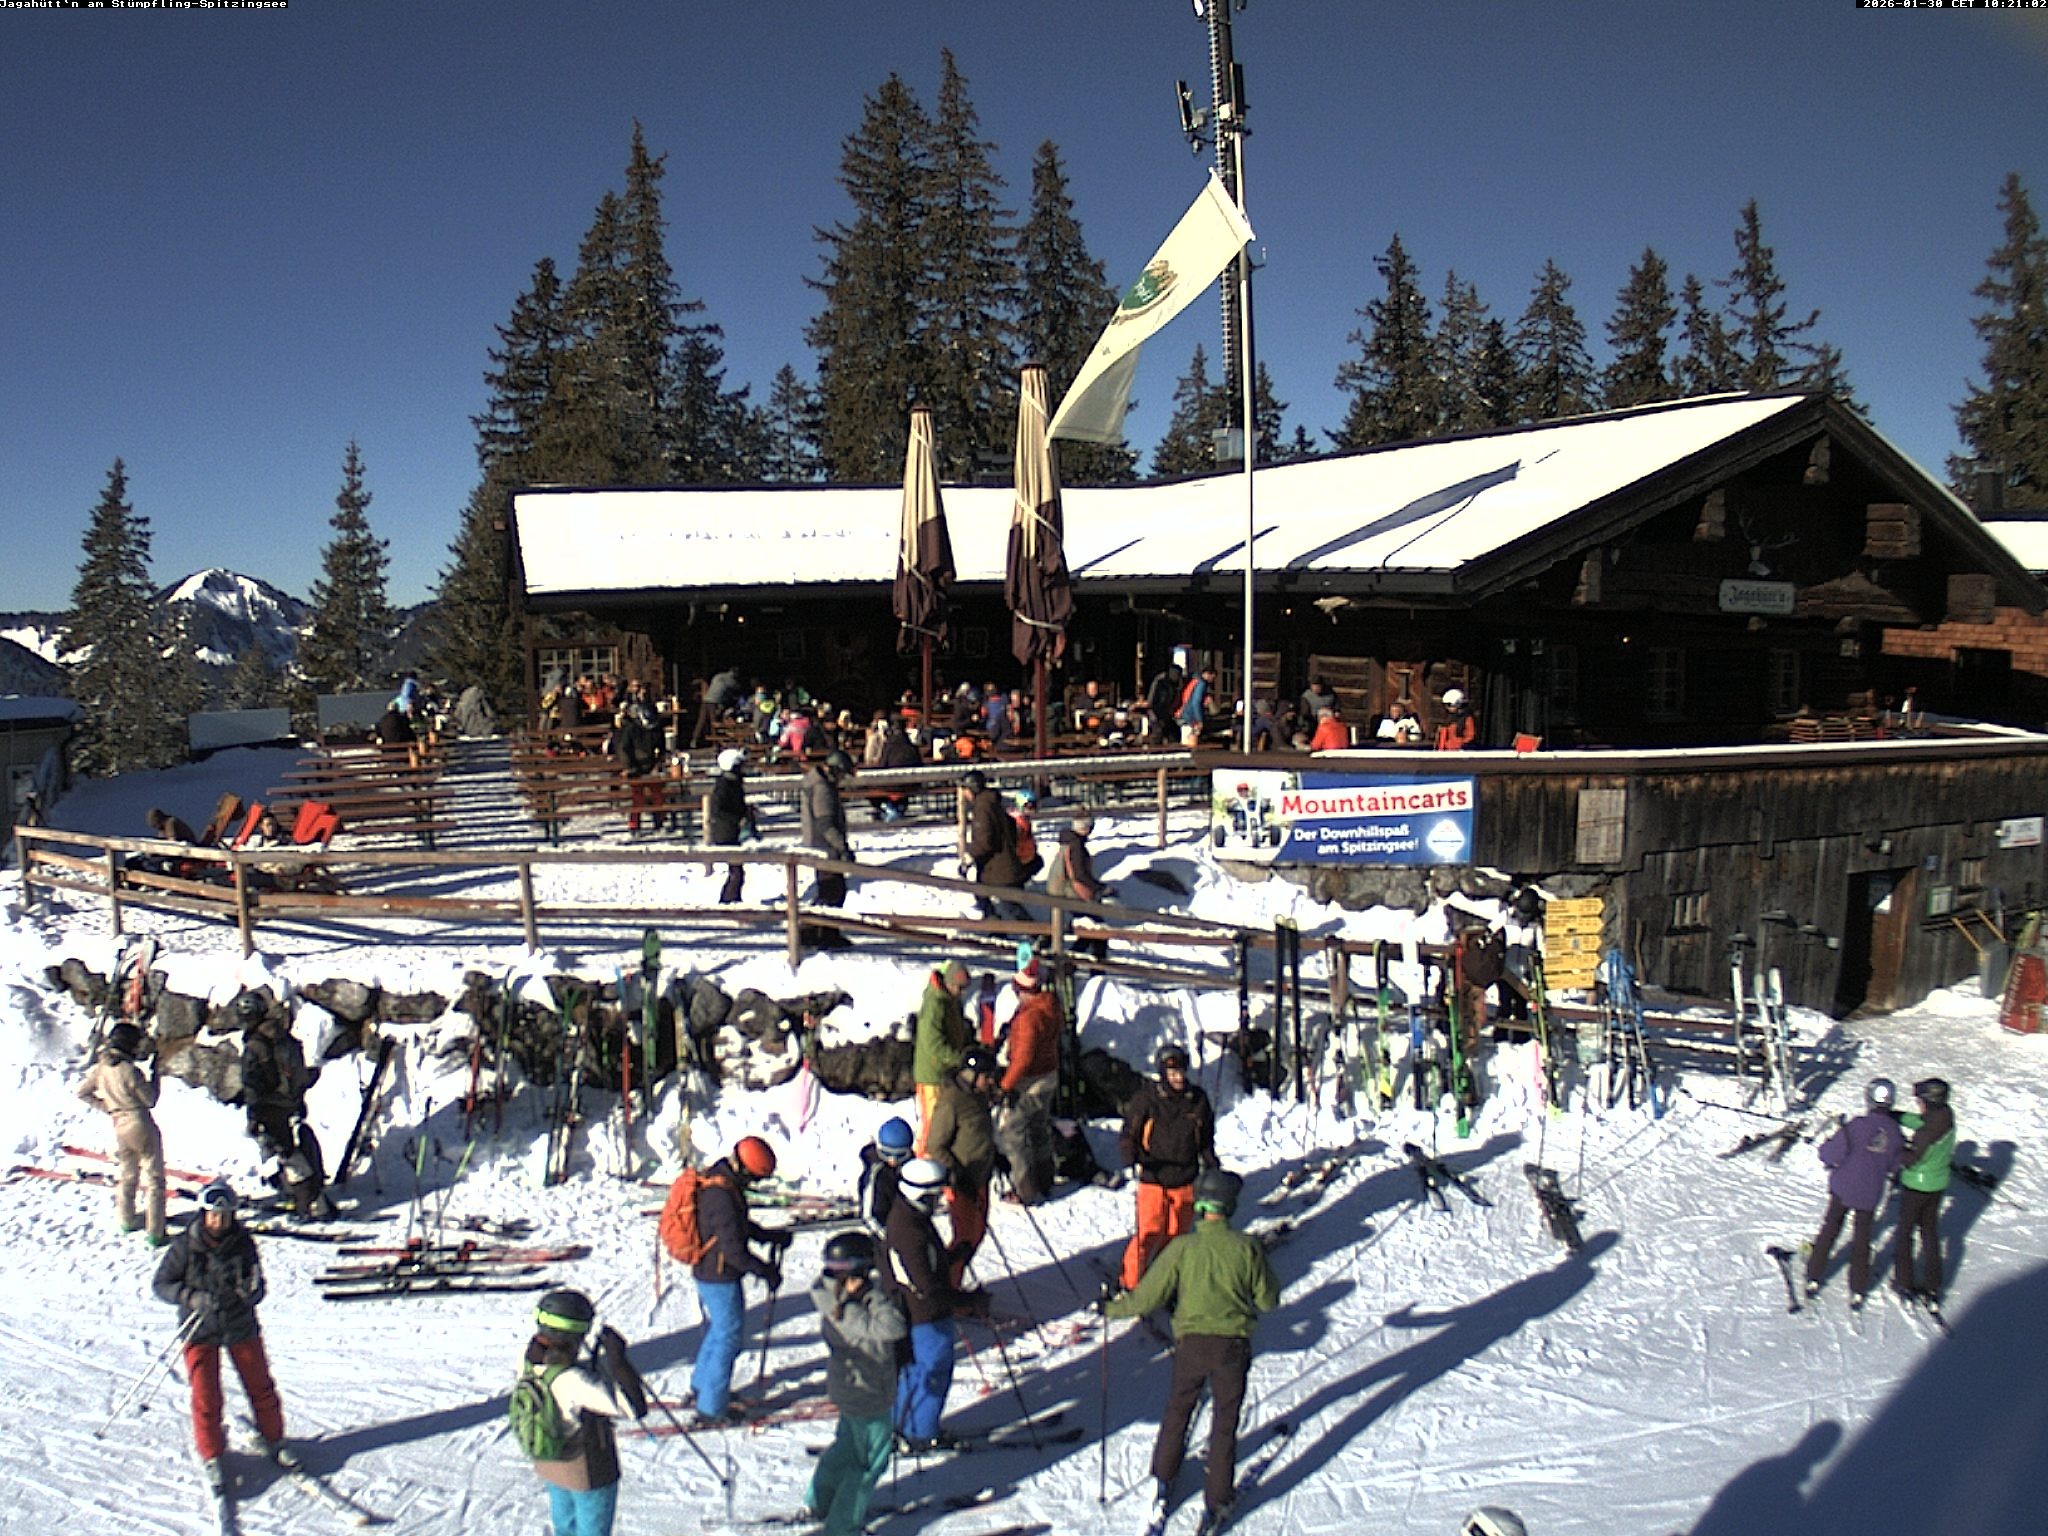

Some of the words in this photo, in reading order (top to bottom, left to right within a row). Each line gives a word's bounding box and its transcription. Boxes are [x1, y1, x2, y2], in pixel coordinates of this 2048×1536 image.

[1281, 788, 1467, 815] Mountaincarts
[1294, 828, 1317, 841] Der
[1320, 824, 1410, 840] Downhillspaß
[1317, 844, 1340, 855] am
[1341, 837, 1419, 856] Spitzingsee!
